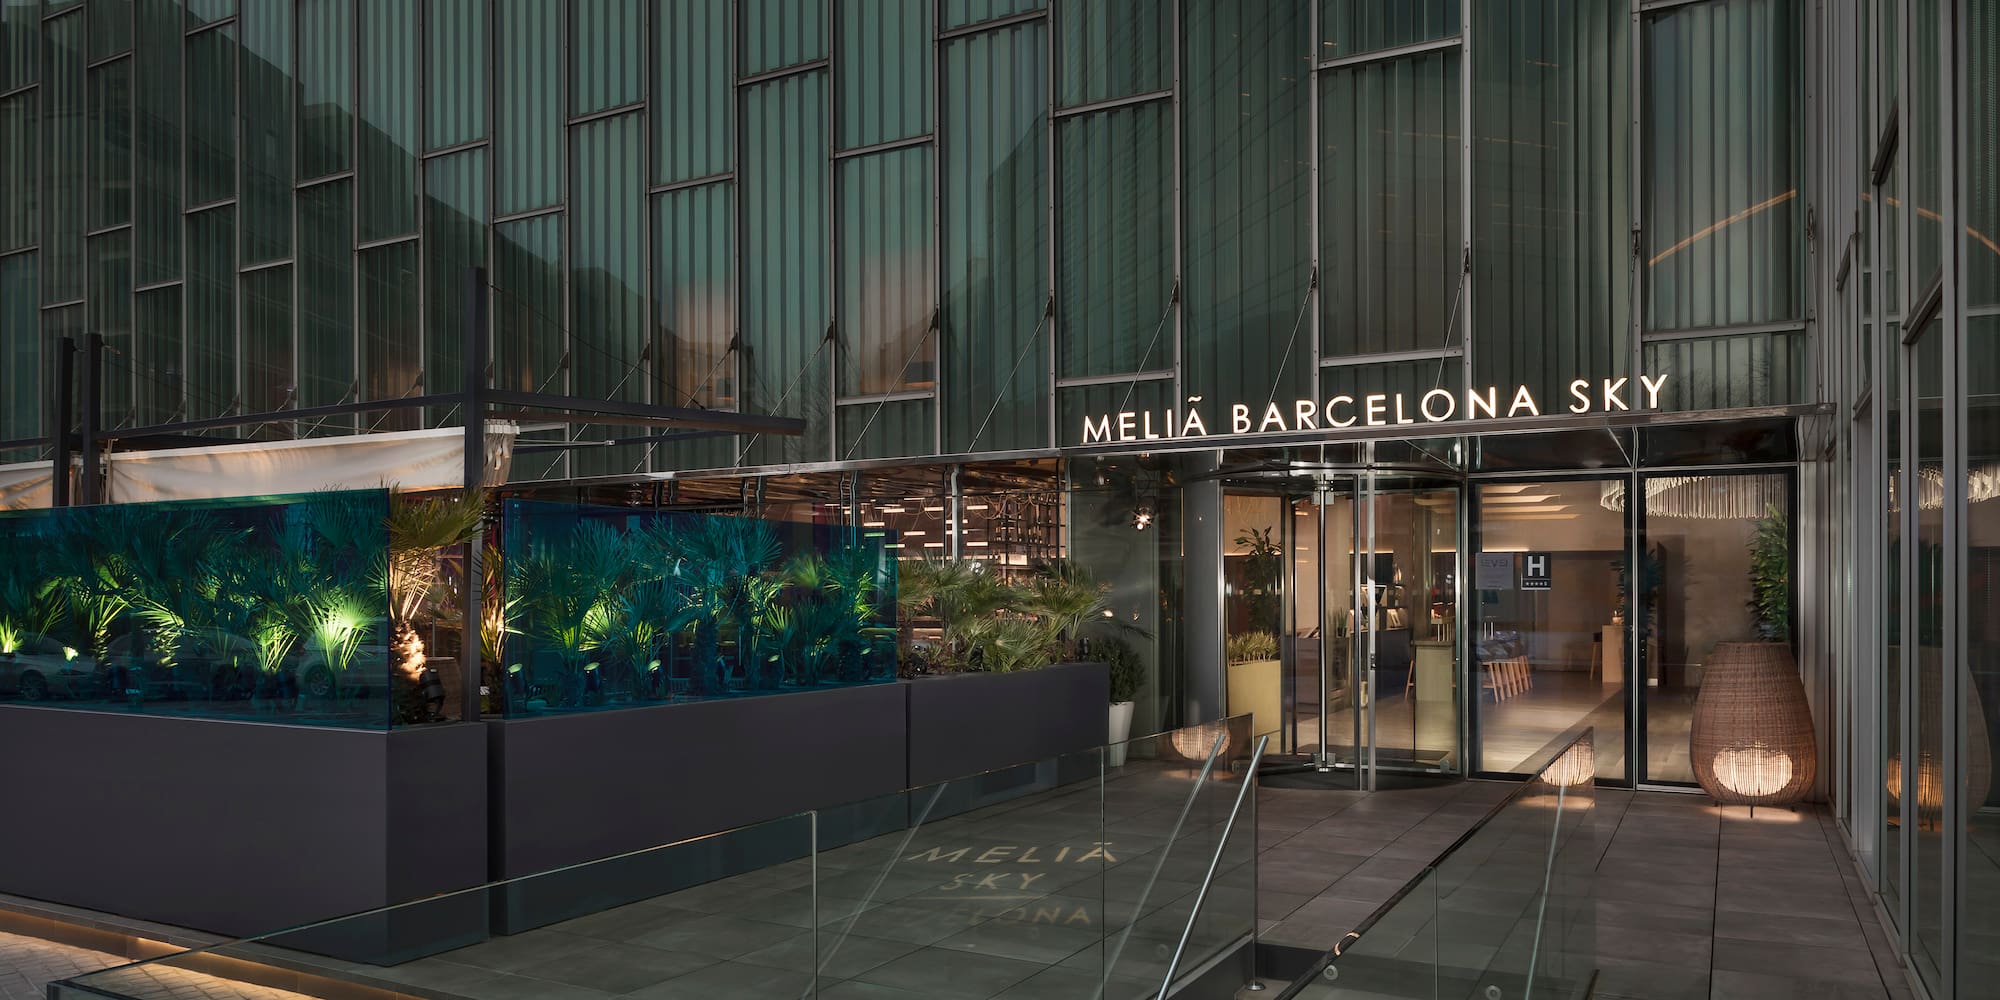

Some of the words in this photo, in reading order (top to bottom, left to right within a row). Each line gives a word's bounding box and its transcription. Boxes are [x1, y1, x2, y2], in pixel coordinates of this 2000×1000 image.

[1232, 385, 1540, 434] BARCELONA
[1568, 373, 1669, 414] SKY
[1527, 555, 1545, 577] H
[940, 872, 1046, 890] SKY
